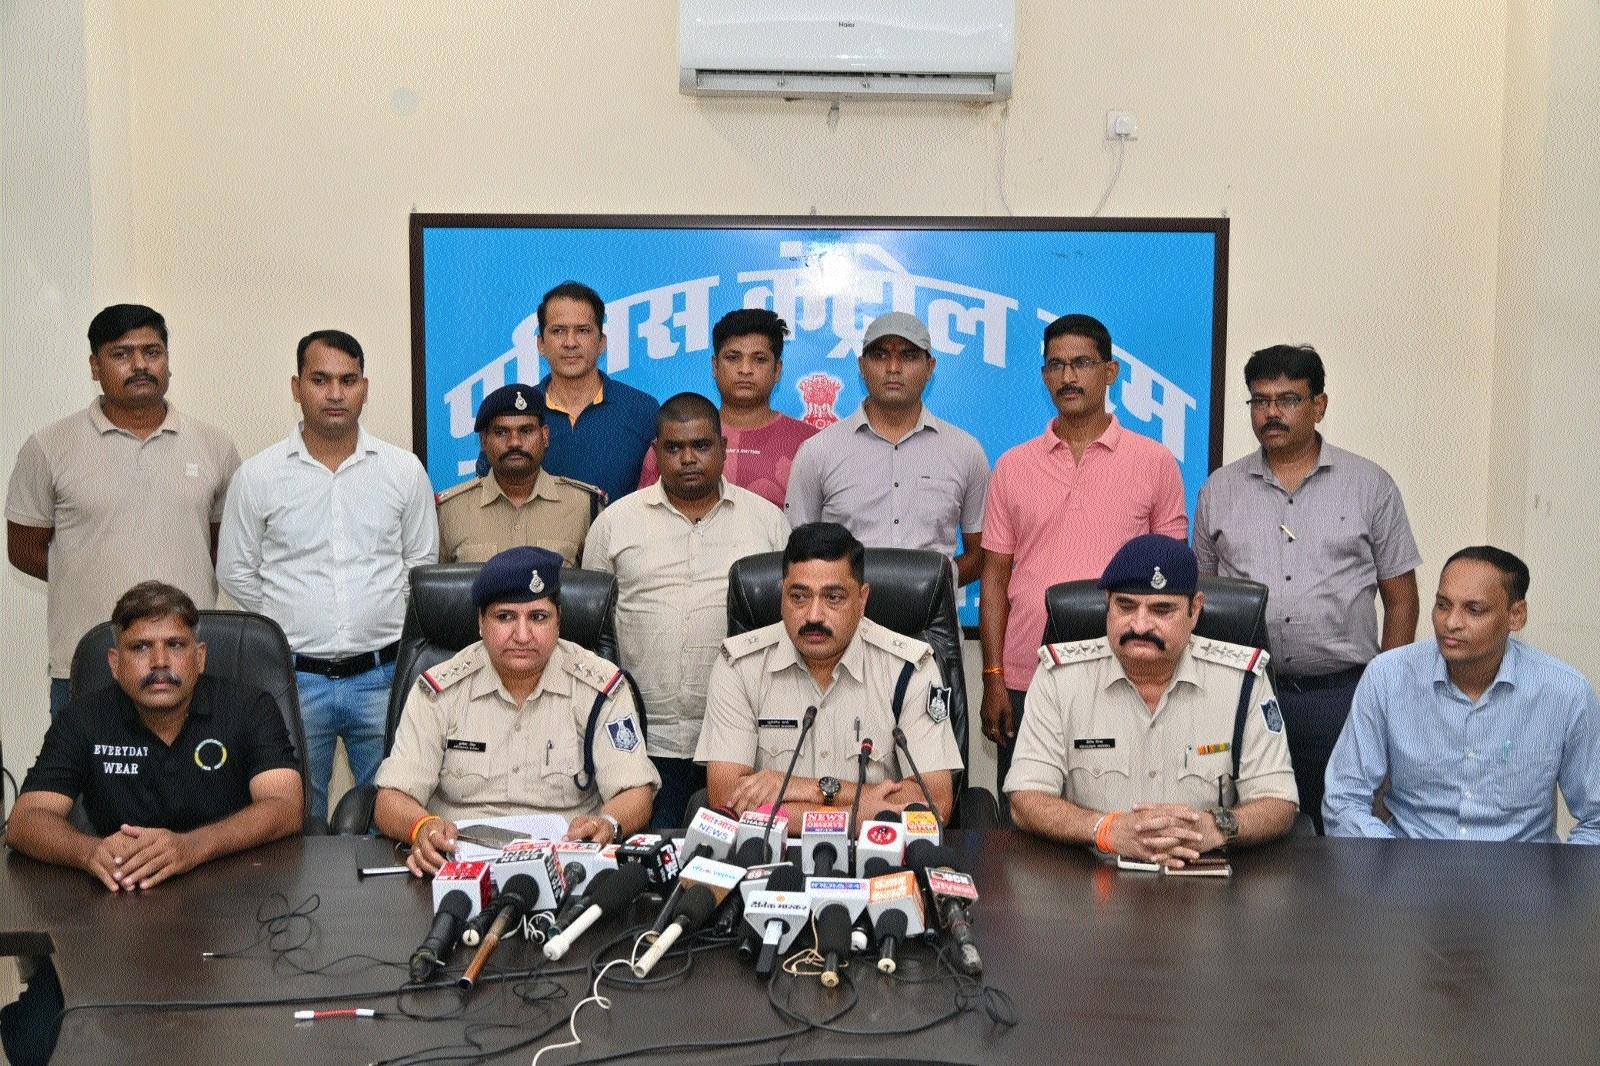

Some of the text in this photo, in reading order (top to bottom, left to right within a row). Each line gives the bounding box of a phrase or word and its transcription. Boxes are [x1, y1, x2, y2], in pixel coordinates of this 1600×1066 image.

[737, 240, 1019, 369] कंट्रोल
[93, 744, 149, 757] EVERYDAY
[103, 761, 139, 775] WEAR
[807, 813, 844, 821] NEWS
[698, 822, 729, 841] NEWS
[501, 853, 539, 863] NEWS
[502, 848, 543, 857] INDIA
